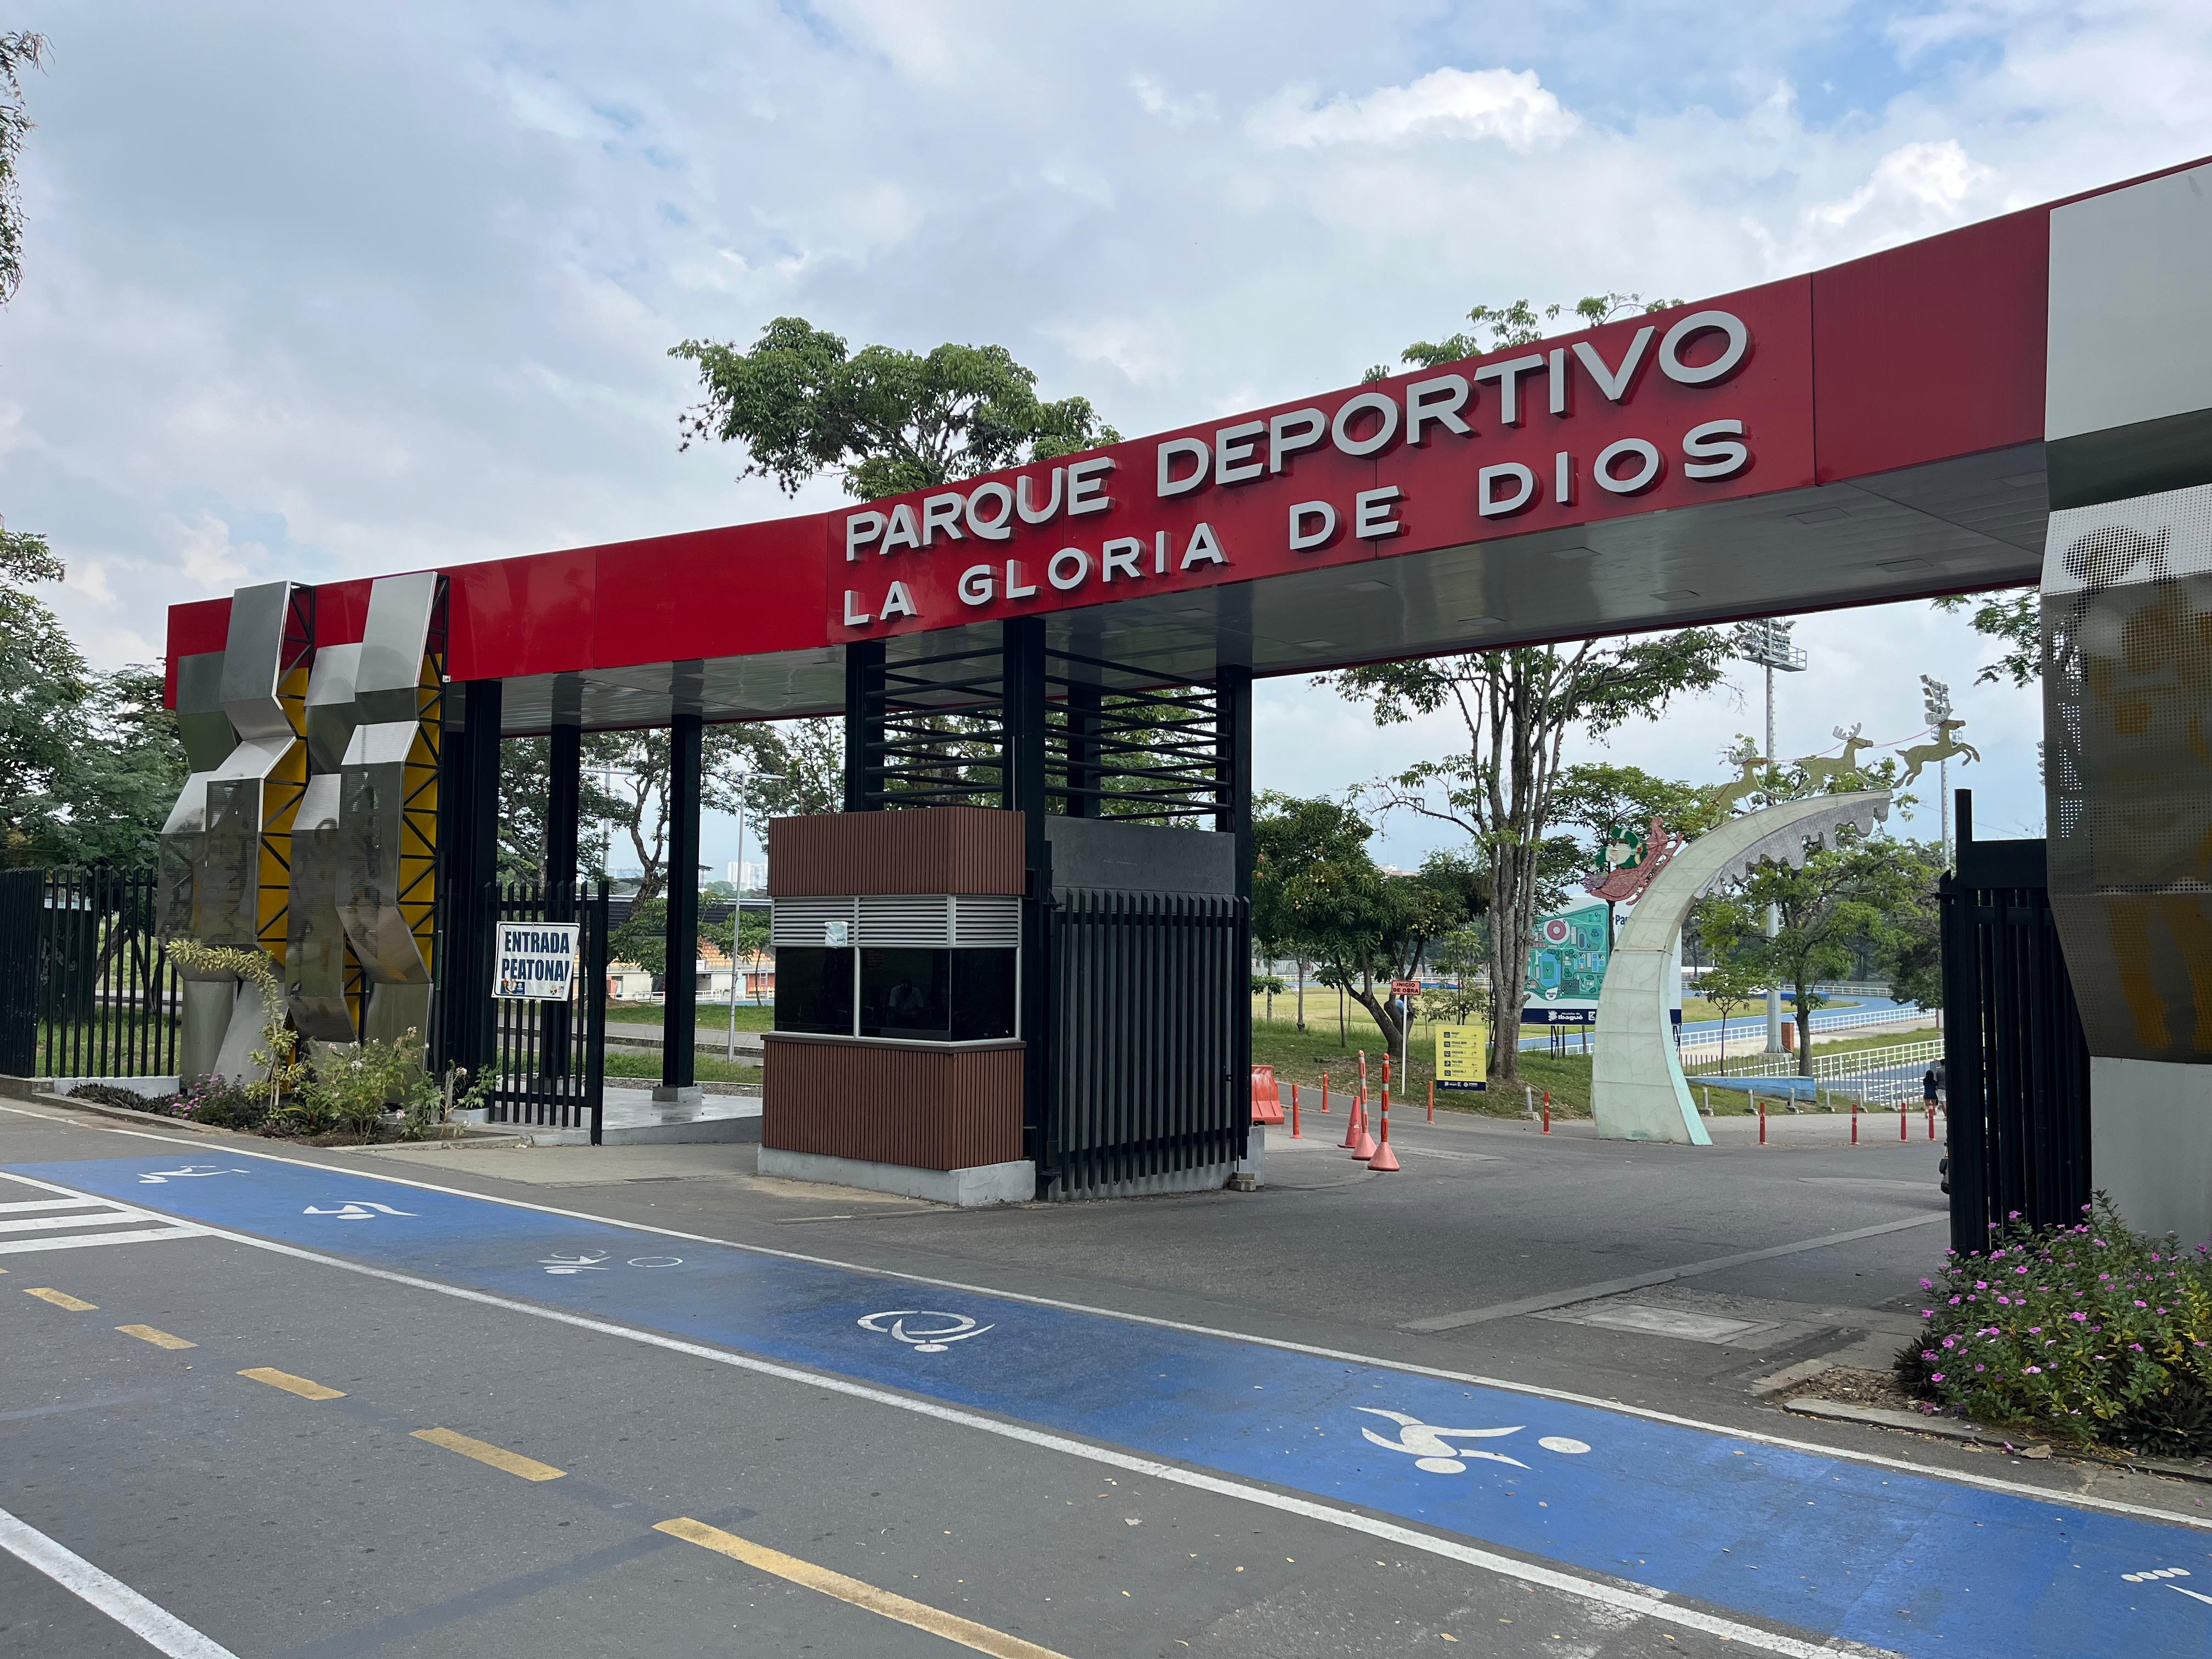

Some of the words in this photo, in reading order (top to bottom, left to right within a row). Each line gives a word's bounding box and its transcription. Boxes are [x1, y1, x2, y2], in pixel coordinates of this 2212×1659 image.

[843, 580, 918, 627] LA
[957, 522, 1227, 607] GLORIA
[1289, 485, 1402, 551] DE
[1478, 419, 1749, 517] DIOS
[845, 455, 1116, 562] PARQUE
[1156, 309, 1749, 498] DEPORTIVO
[505, 931, 570, 953] ENTRADA
